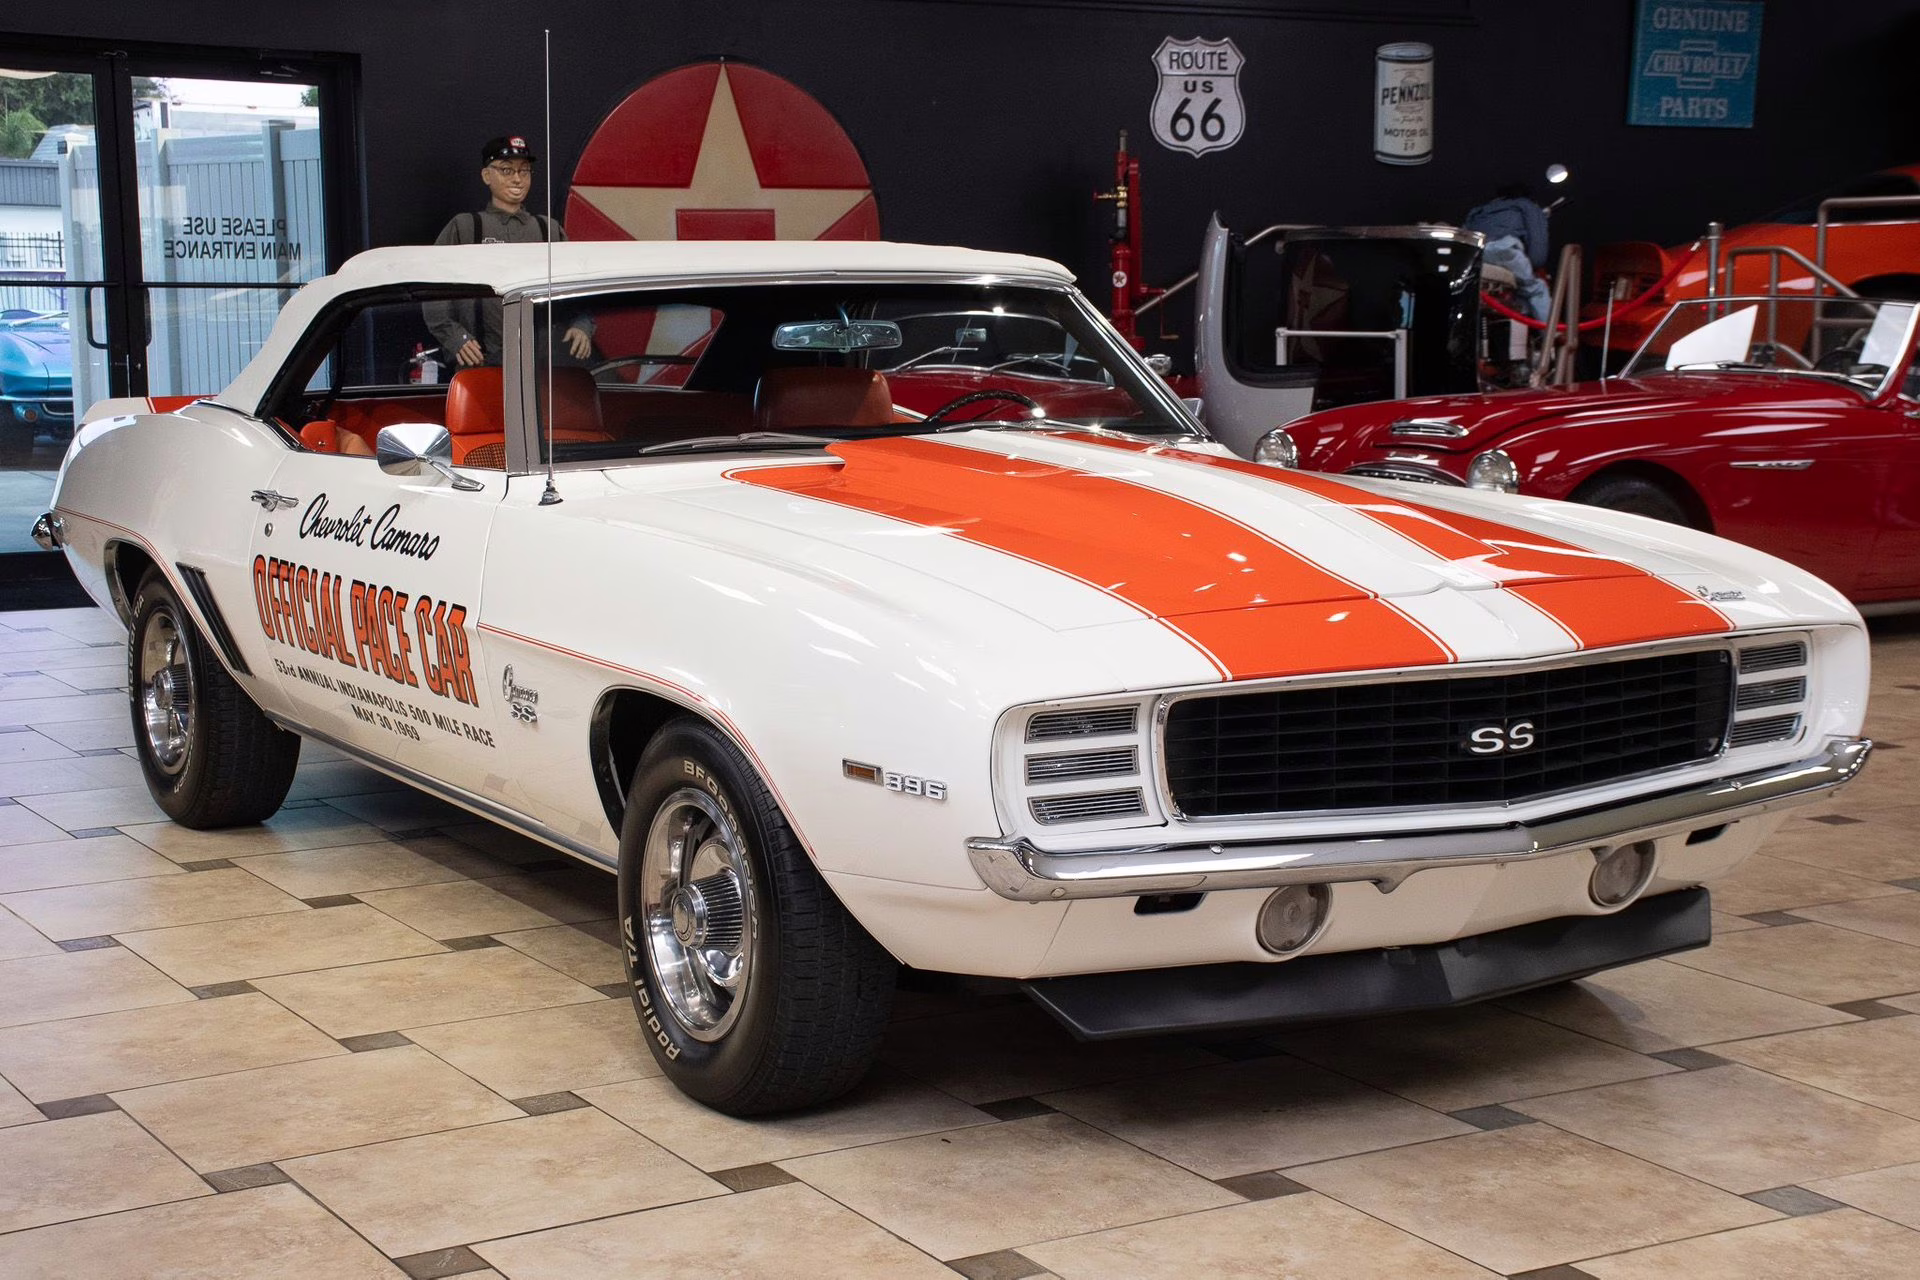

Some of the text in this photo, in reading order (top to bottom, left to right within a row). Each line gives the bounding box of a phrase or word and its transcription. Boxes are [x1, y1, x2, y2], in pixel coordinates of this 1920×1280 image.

[1652, 7, 1749, 32] GENUINE
[1169, 51, 1228, 70] ROUTE
[1652, 54, 1744, 75] CHEVROLET
[1170, 97, 1226, 142] 66
[1658, 95, 1729, 119] PARTS
[1384, 128, 1418, 138] MOTOR
[299, 492, 441, 561] Chevrolet Camaro
[253, 554, 480, 708] OFFICIAL PACE CAR
[274, 658, 496, 748] 53rd ANNUAL INDIANAPOLIS 500 MILE RACE
[351, 703, 377, 725] MAY
[510, 701, 538, 723] SS
[1469, 722, 1534, 754] SS
[884, 771, 948, 802] 396
[623, 915, 682, 1061] Radial T/A
